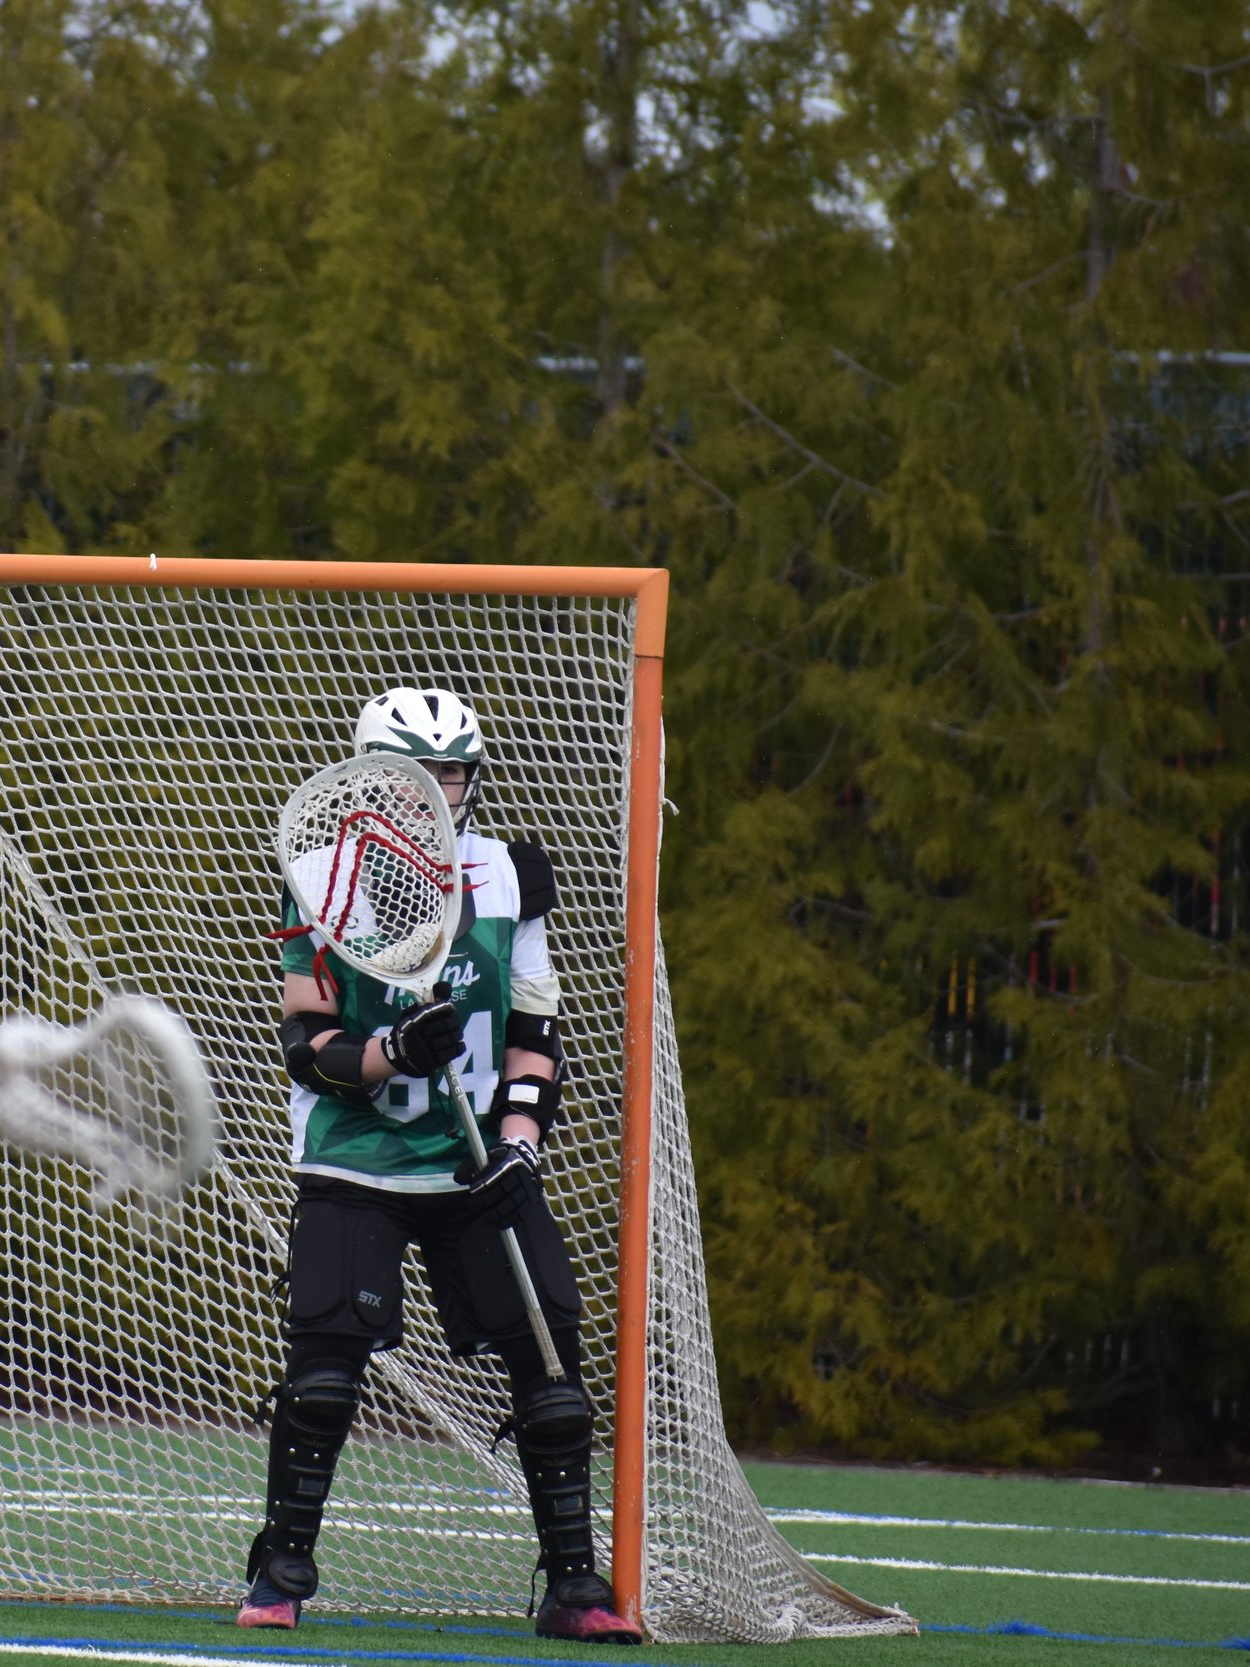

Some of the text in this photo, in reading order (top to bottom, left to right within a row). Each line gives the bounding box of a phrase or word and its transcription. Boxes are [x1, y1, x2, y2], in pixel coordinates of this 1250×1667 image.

[399, 989, 468, 1010] LASE
[542, 1020, 551, 1036] STX
[358, 1290, 382, 1308] STX
